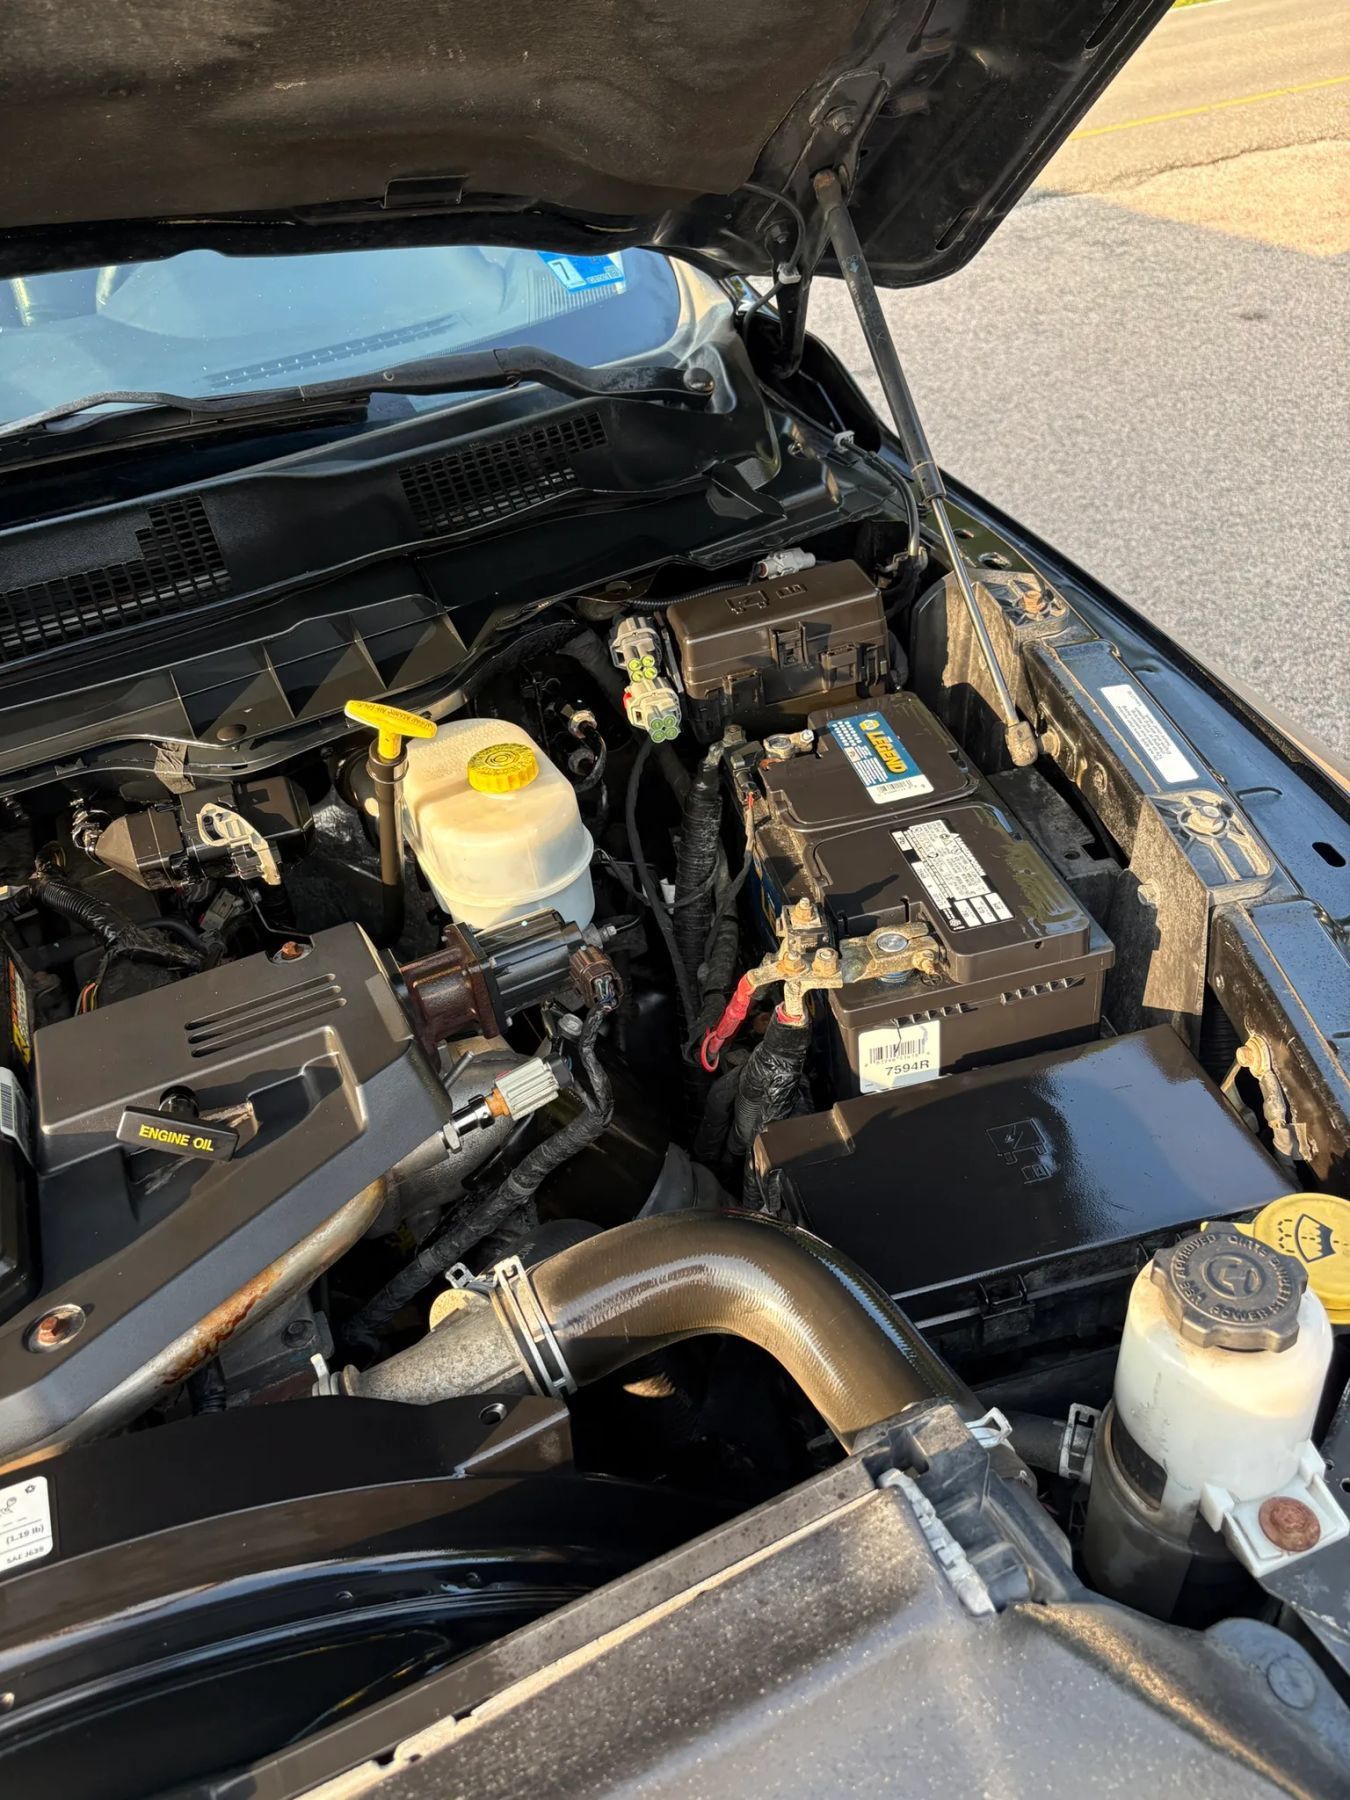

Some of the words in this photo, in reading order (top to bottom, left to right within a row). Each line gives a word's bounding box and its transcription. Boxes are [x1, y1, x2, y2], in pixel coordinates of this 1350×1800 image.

[552, 261, 570, 281] 7
[864, 730, 908, 774] LEGEND
[885, 1059, 930, 1076] 7594R
[139, 1123, 191, 1147] ENGINE
[192, 1135, 214, 1152] OIL
[1174, 1233, 1217, 1280] APPROVED
[1209, 1305, 1268, 1322] POWER
